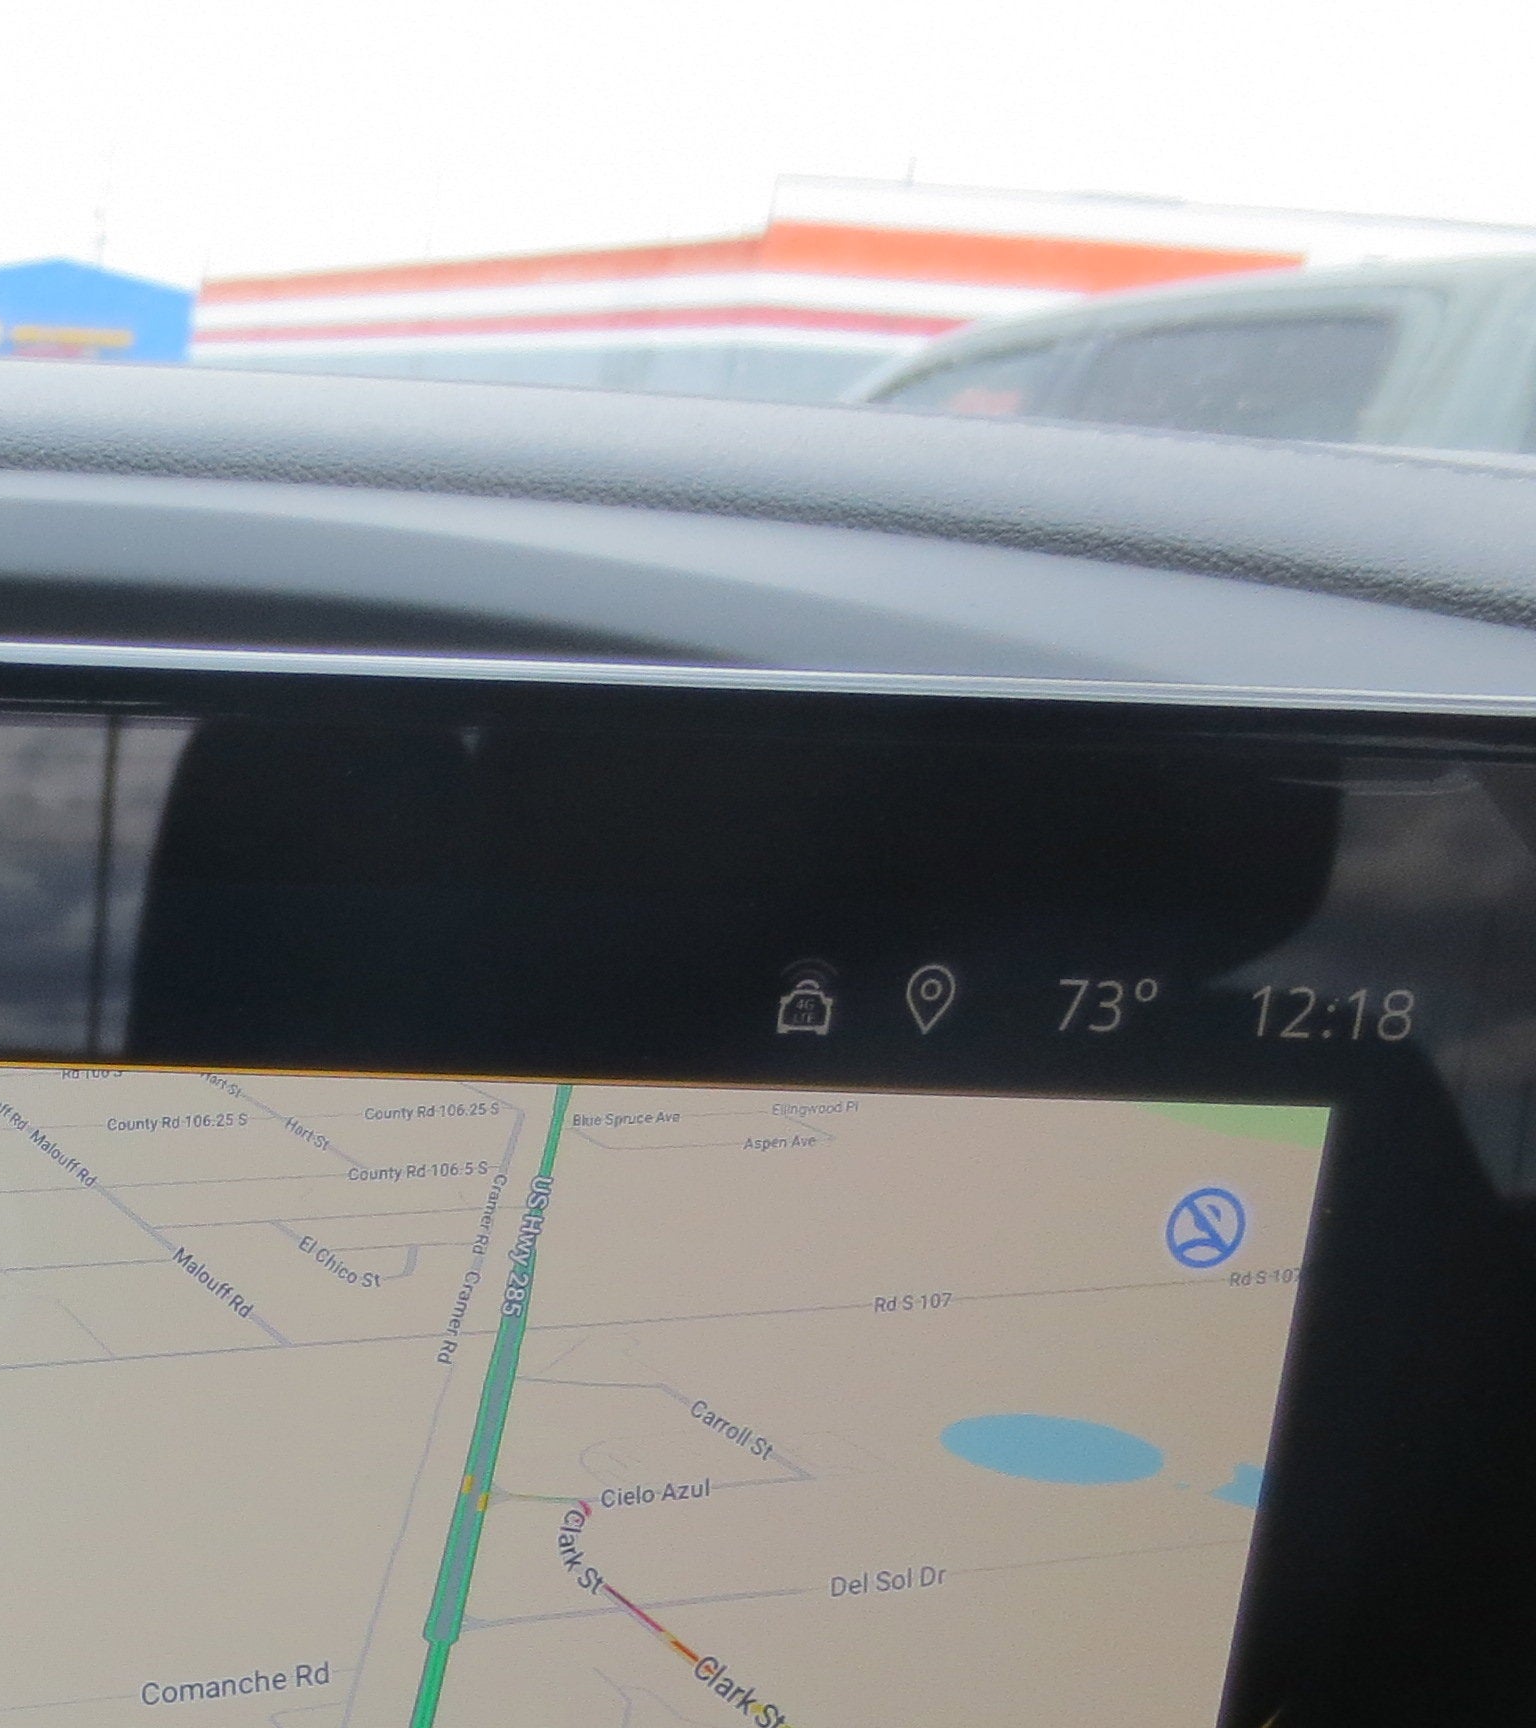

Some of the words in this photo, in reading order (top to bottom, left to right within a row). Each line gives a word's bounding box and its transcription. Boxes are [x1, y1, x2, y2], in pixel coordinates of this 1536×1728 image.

[1251, 985, 1419, 1042] 12:18
[224, 1083, 242, 1099] St
[9, 1111, 28, 1132] Rd
[107, 1117, 158, 1132] County
[162, 1116, 180, 1130] Rd
[185, 1114, 233, 1129] 106.25
[237, 1113, 248, 1126] S
[364, 1107, 413, 1121] County
[417, 1105, 435, 1118] Rd
[439, 1103, 486, 1118] 106.25
[489, 1103, 500, 1115] S
[572, 1113, 602, 1127] Blue
[604, 1112, 652, 1128] Spruce
[656, 1110, 681, 1124] Ave
[284, 1117, 315, 1142] Hart
[312, 1134, 330, 1152] St
[743, 1136, 787, 1152] Aspen
[792, 1135, 817, 1149] Ave
[29, 1130, 81, 1175] Malouff
[77, 1164, 98, 1188] Rd
[348, 1167, 402, 1183] County
[406, 1164, 426, 1179] Rd
[477, 1161, 489, 1175] S
[478, 1173, 508, 1232] Cramer
[525, 1175, 554, 1210] US
[471, 1233, 490, 1256] Rd
[508, 1213, 545, 1267] Hwy
[298, 1235, 315, 1253] El
[314, 1248, 358, 1287] Chico
[360, 1271, 382, 1288] St
[1229, 1271, 1252, 1287] Rd
[1255, 1270, 1267, 1284] S
[172, 1246, 234, 1300] Malouff
[228, 1293, 255, 1319] Rd
[501, 1270, 529, 1319] 285
[446, 1270, 481, 1338] Cramer
[873, 1294, 898, 1313] Rd
[902, 1293, 915, 1311] S
[919, 1291, 953, 1310] 107
[436, 1340, 459, 1366] Rd
[689, 1400, 751, 1447] Carroll
[749, 1437, 775, 1462] St
[600, 1484, 655, 1509] Cielo
[661, 1478, 711, 1502] Azul
[557, 1508, 586, 1573] Clark
[576, 1567, 606, 1596] St
[830, 1571, 868, 1598] Del
[875, 1567, 913, 1592] Sol
[920, 1566, 947, 1588] Dr
[139, 1668, 288, 1708] Comanche
[295, 1660, 331, 1690] Rd
[693, 1655, 761, 1718] Clark
